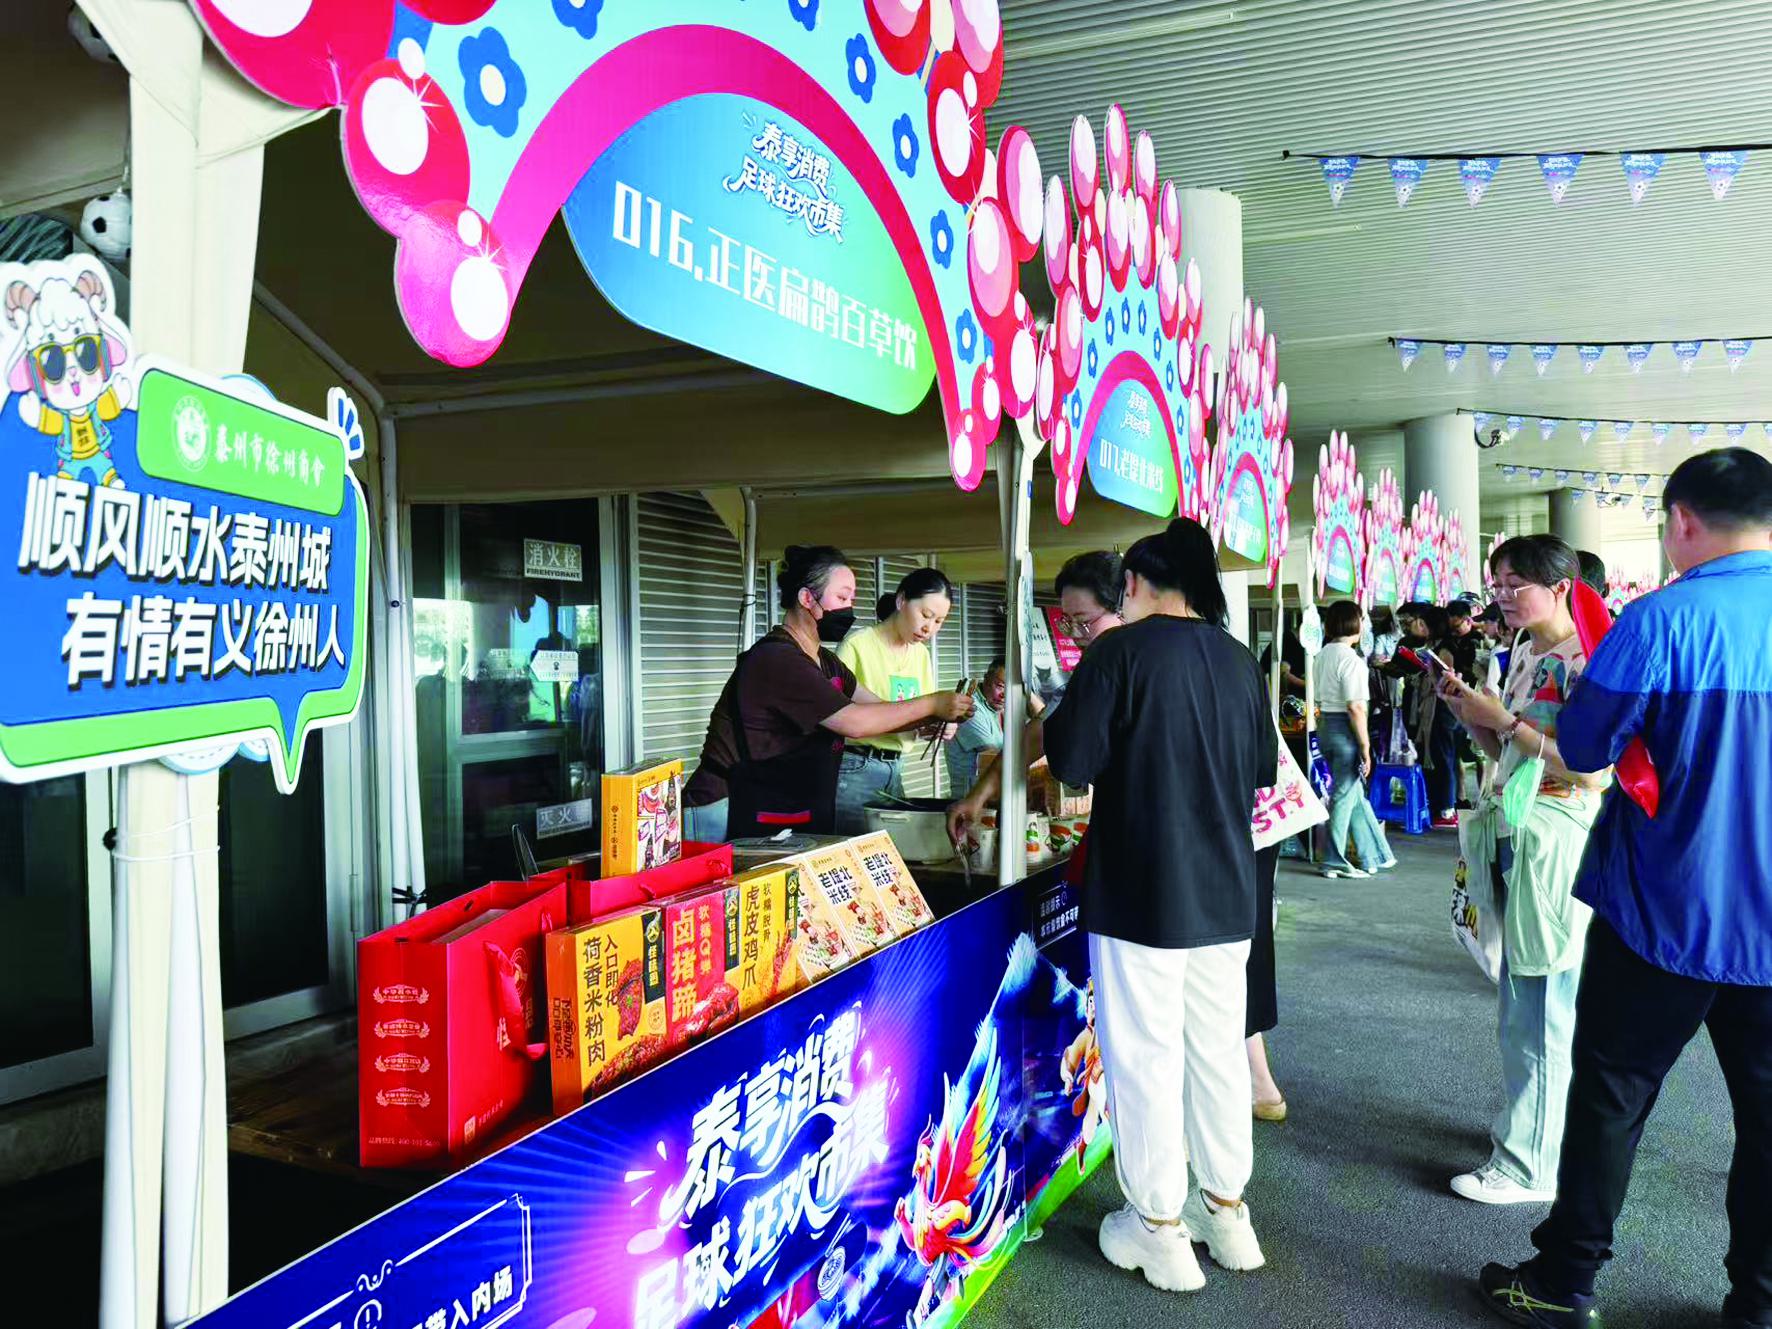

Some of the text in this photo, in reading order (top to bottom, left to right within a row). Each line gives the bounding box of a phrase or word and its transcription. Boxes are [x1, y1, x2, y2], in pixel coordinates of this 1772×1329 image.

[722, 153, 844, 244] 足球狂欢市集
[752, 120, 831, 199] 泰享消费
[18, 472, 331, 590] 顺风顺水泰州城
[528, 541, 578, 569] 消火栓
[61, 592, 346, 687] 有情有义徐州人
[604, 934, 619, 1009] 入口即化
[671, 908, 697, 1023] 卤猪蹄
[742, 884, 760, 990] 虎皮鸡爪
[583, 936, 606, 1067] 荷香米粉肉
[659, 1008, 860, 1220] 泰享消费
[633, 1078, 890, 1329] 足球狂欢市集
